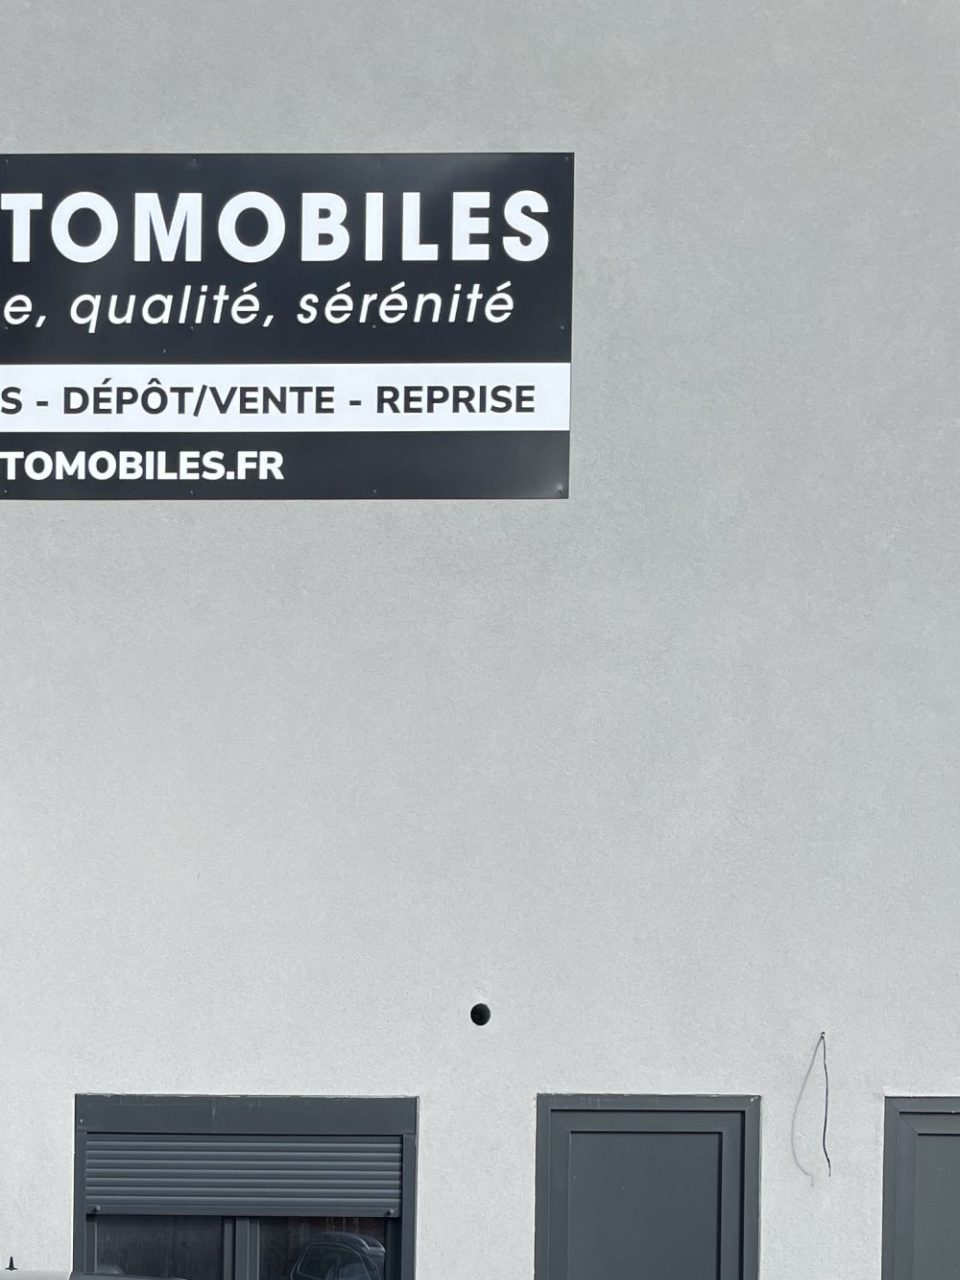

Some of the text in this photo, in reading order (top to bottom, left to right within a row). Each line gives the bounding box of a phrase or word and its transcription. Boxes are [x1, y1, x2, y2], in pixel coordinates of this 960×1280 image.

[70, 281, 274, 334] qualité,
[296, 280, 514, 324] sérénité
[63, 377, 335, 417] DÉPÔT/VENTE
[376, 385, 535, 414] REPRISE
